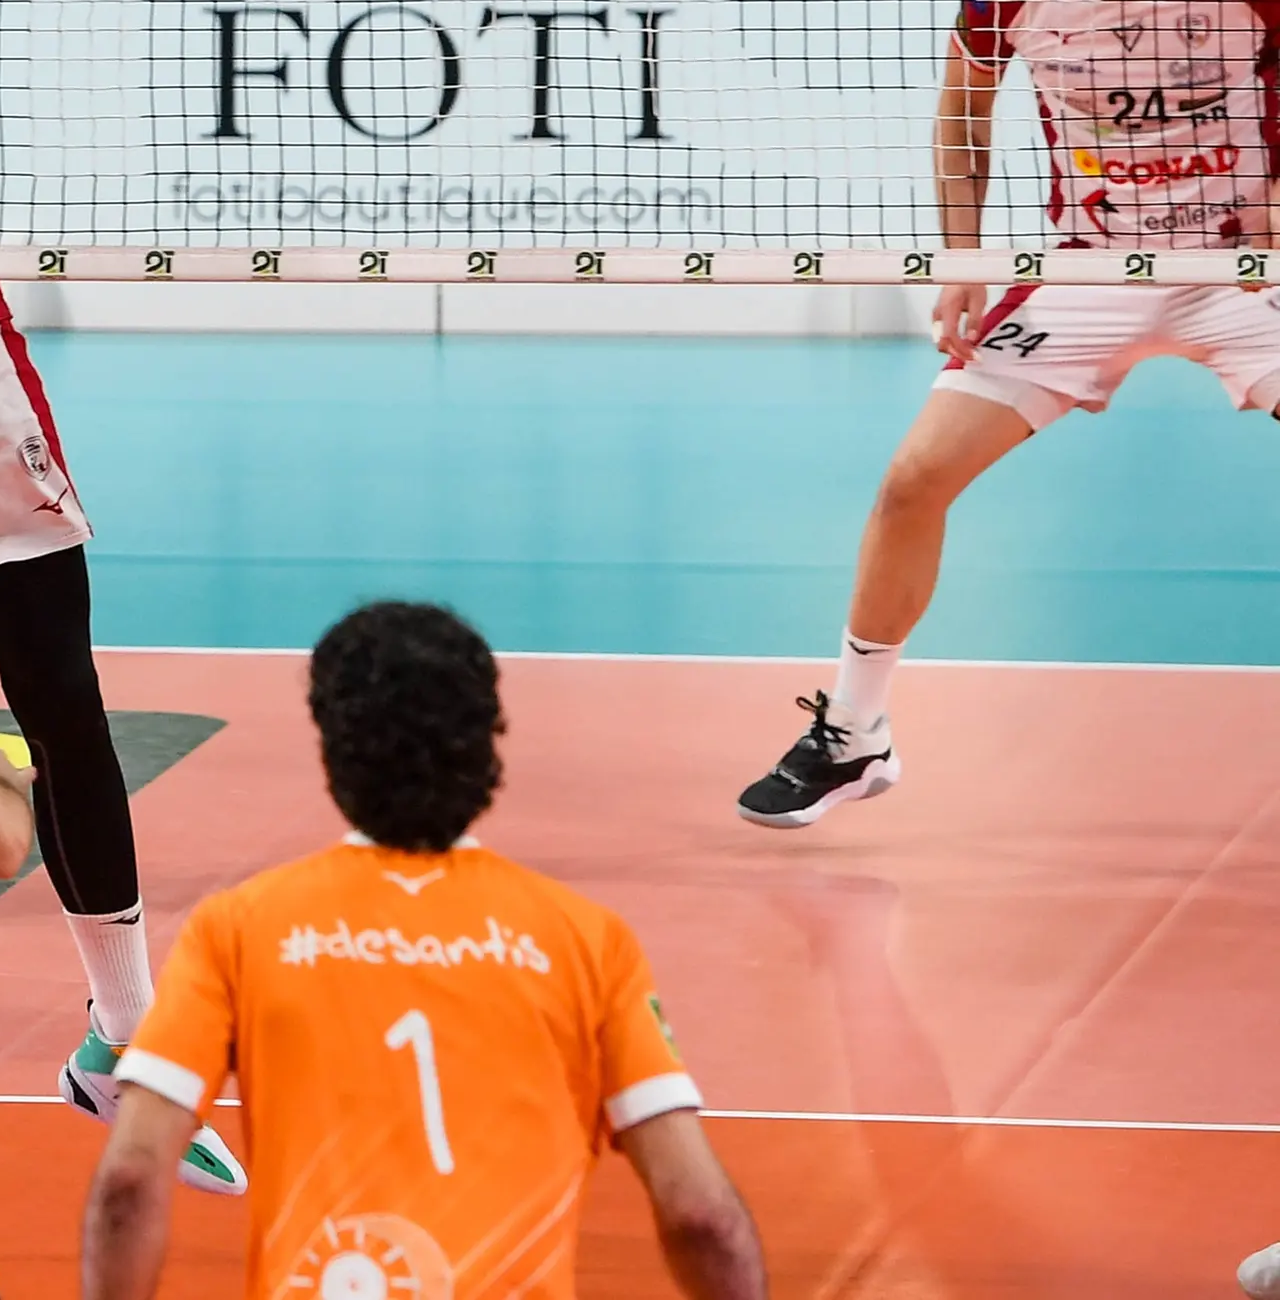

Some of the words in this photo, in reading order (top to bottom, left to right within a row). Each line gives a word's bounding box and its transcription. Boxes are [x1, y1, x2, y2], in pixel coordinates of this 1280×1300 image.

[201, 5, 677, 143] FOTI
[1108, 90, 1171, 129] 24
[1104, 145, 1240, 185] CONAD
[172, 174, 711, 230] fotiboutique.com
[982, 322, 1049, 359] 24
[278, 917, 552, 975] #desantis
[383, 1009, 455, 1175] 1
